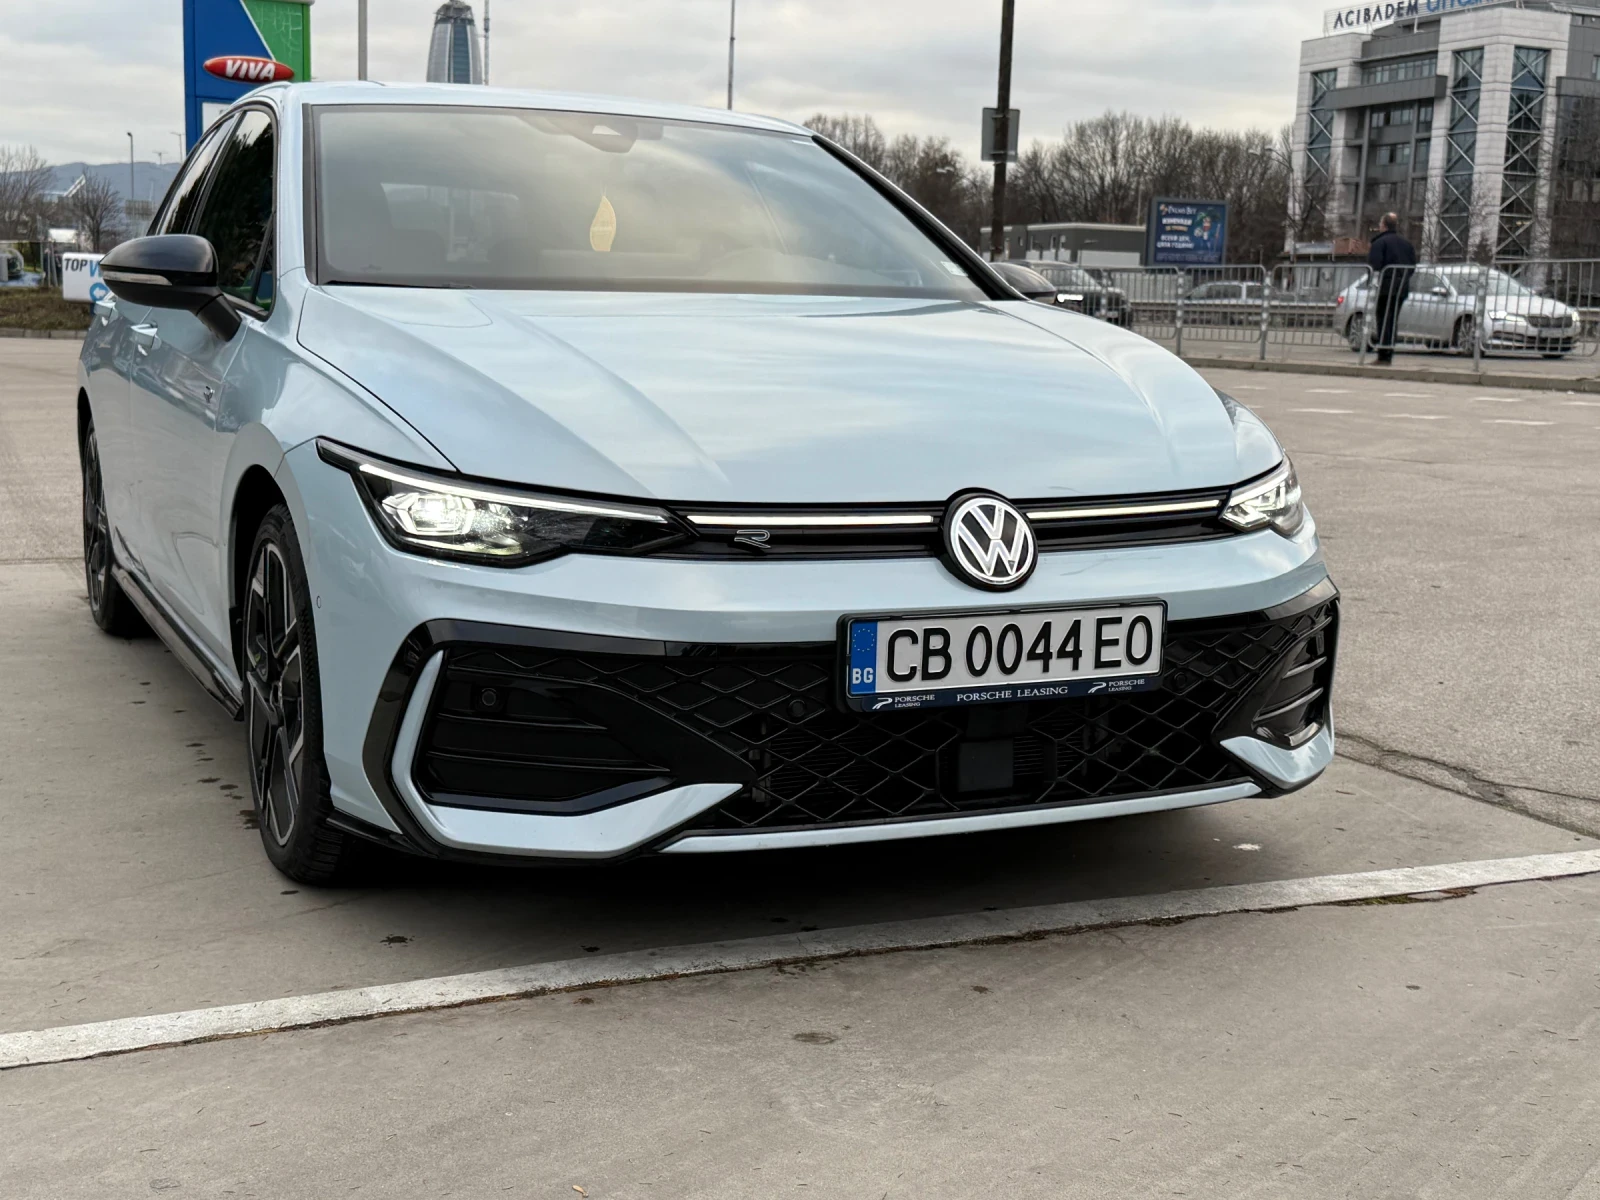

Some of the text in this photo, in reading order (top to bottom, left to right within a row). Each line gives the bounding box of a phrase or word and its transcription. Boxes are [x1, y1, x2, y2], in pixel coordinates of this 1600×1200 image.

[1333, 0, 1419, 29] ACIBADEM
[225, 58, 276, 82] VIVA
[64, 258, 88, 272] TOP
[886, 614, 1154, 683] CB 0044 EO
[852, 667, 874, 685] BG
[1108, 677, 1146, 687] PORSCHE
[956, 686, 1069, 703] PORSCHE LEASING
[1108, 684, 1133, 692] LEASING
[894, 694, 936, 704] PORSCHE
